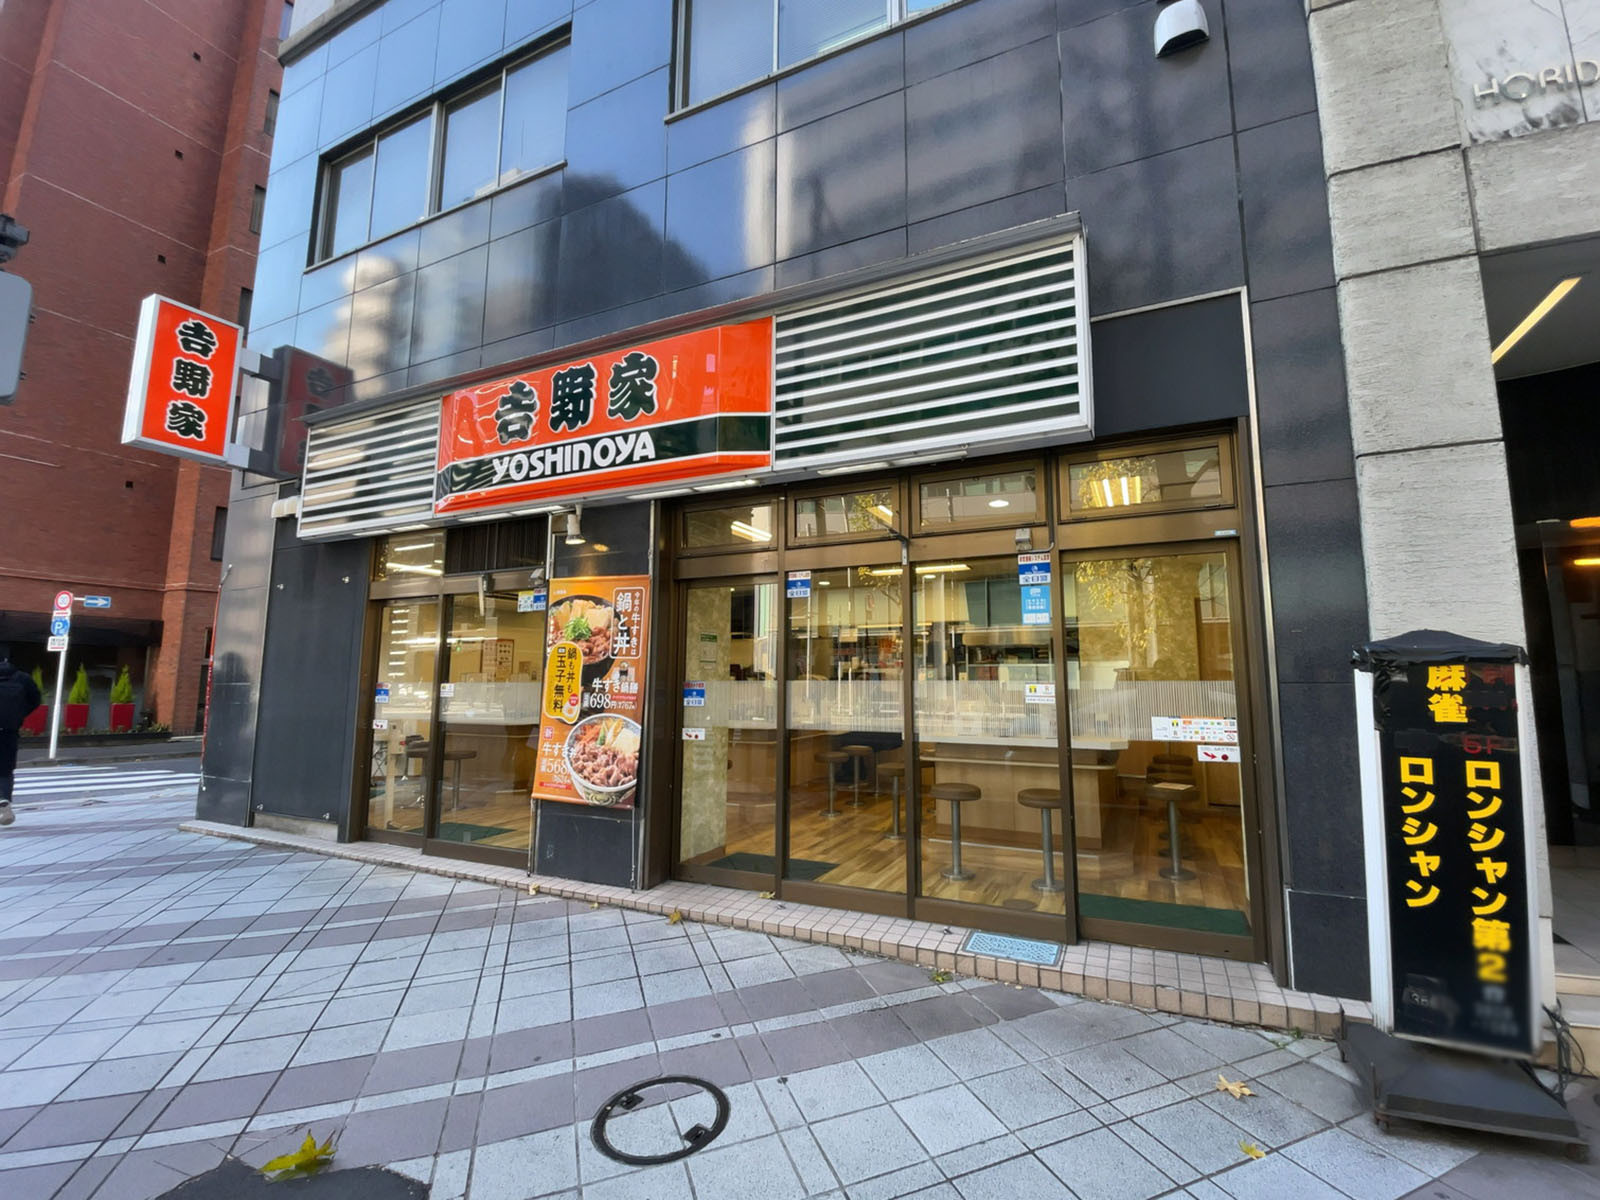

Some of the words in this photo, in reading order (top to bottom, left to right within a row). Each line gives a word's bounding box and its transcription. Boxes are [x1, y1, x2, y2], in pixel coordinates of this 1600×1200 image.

[166, 318, 219, 441] 吉野家
[495, 351, 659, 445] 吉野家
[613, 592, 632, 655] 鍋と丼
[1400, 756, 1441, 908] ロンシャン
